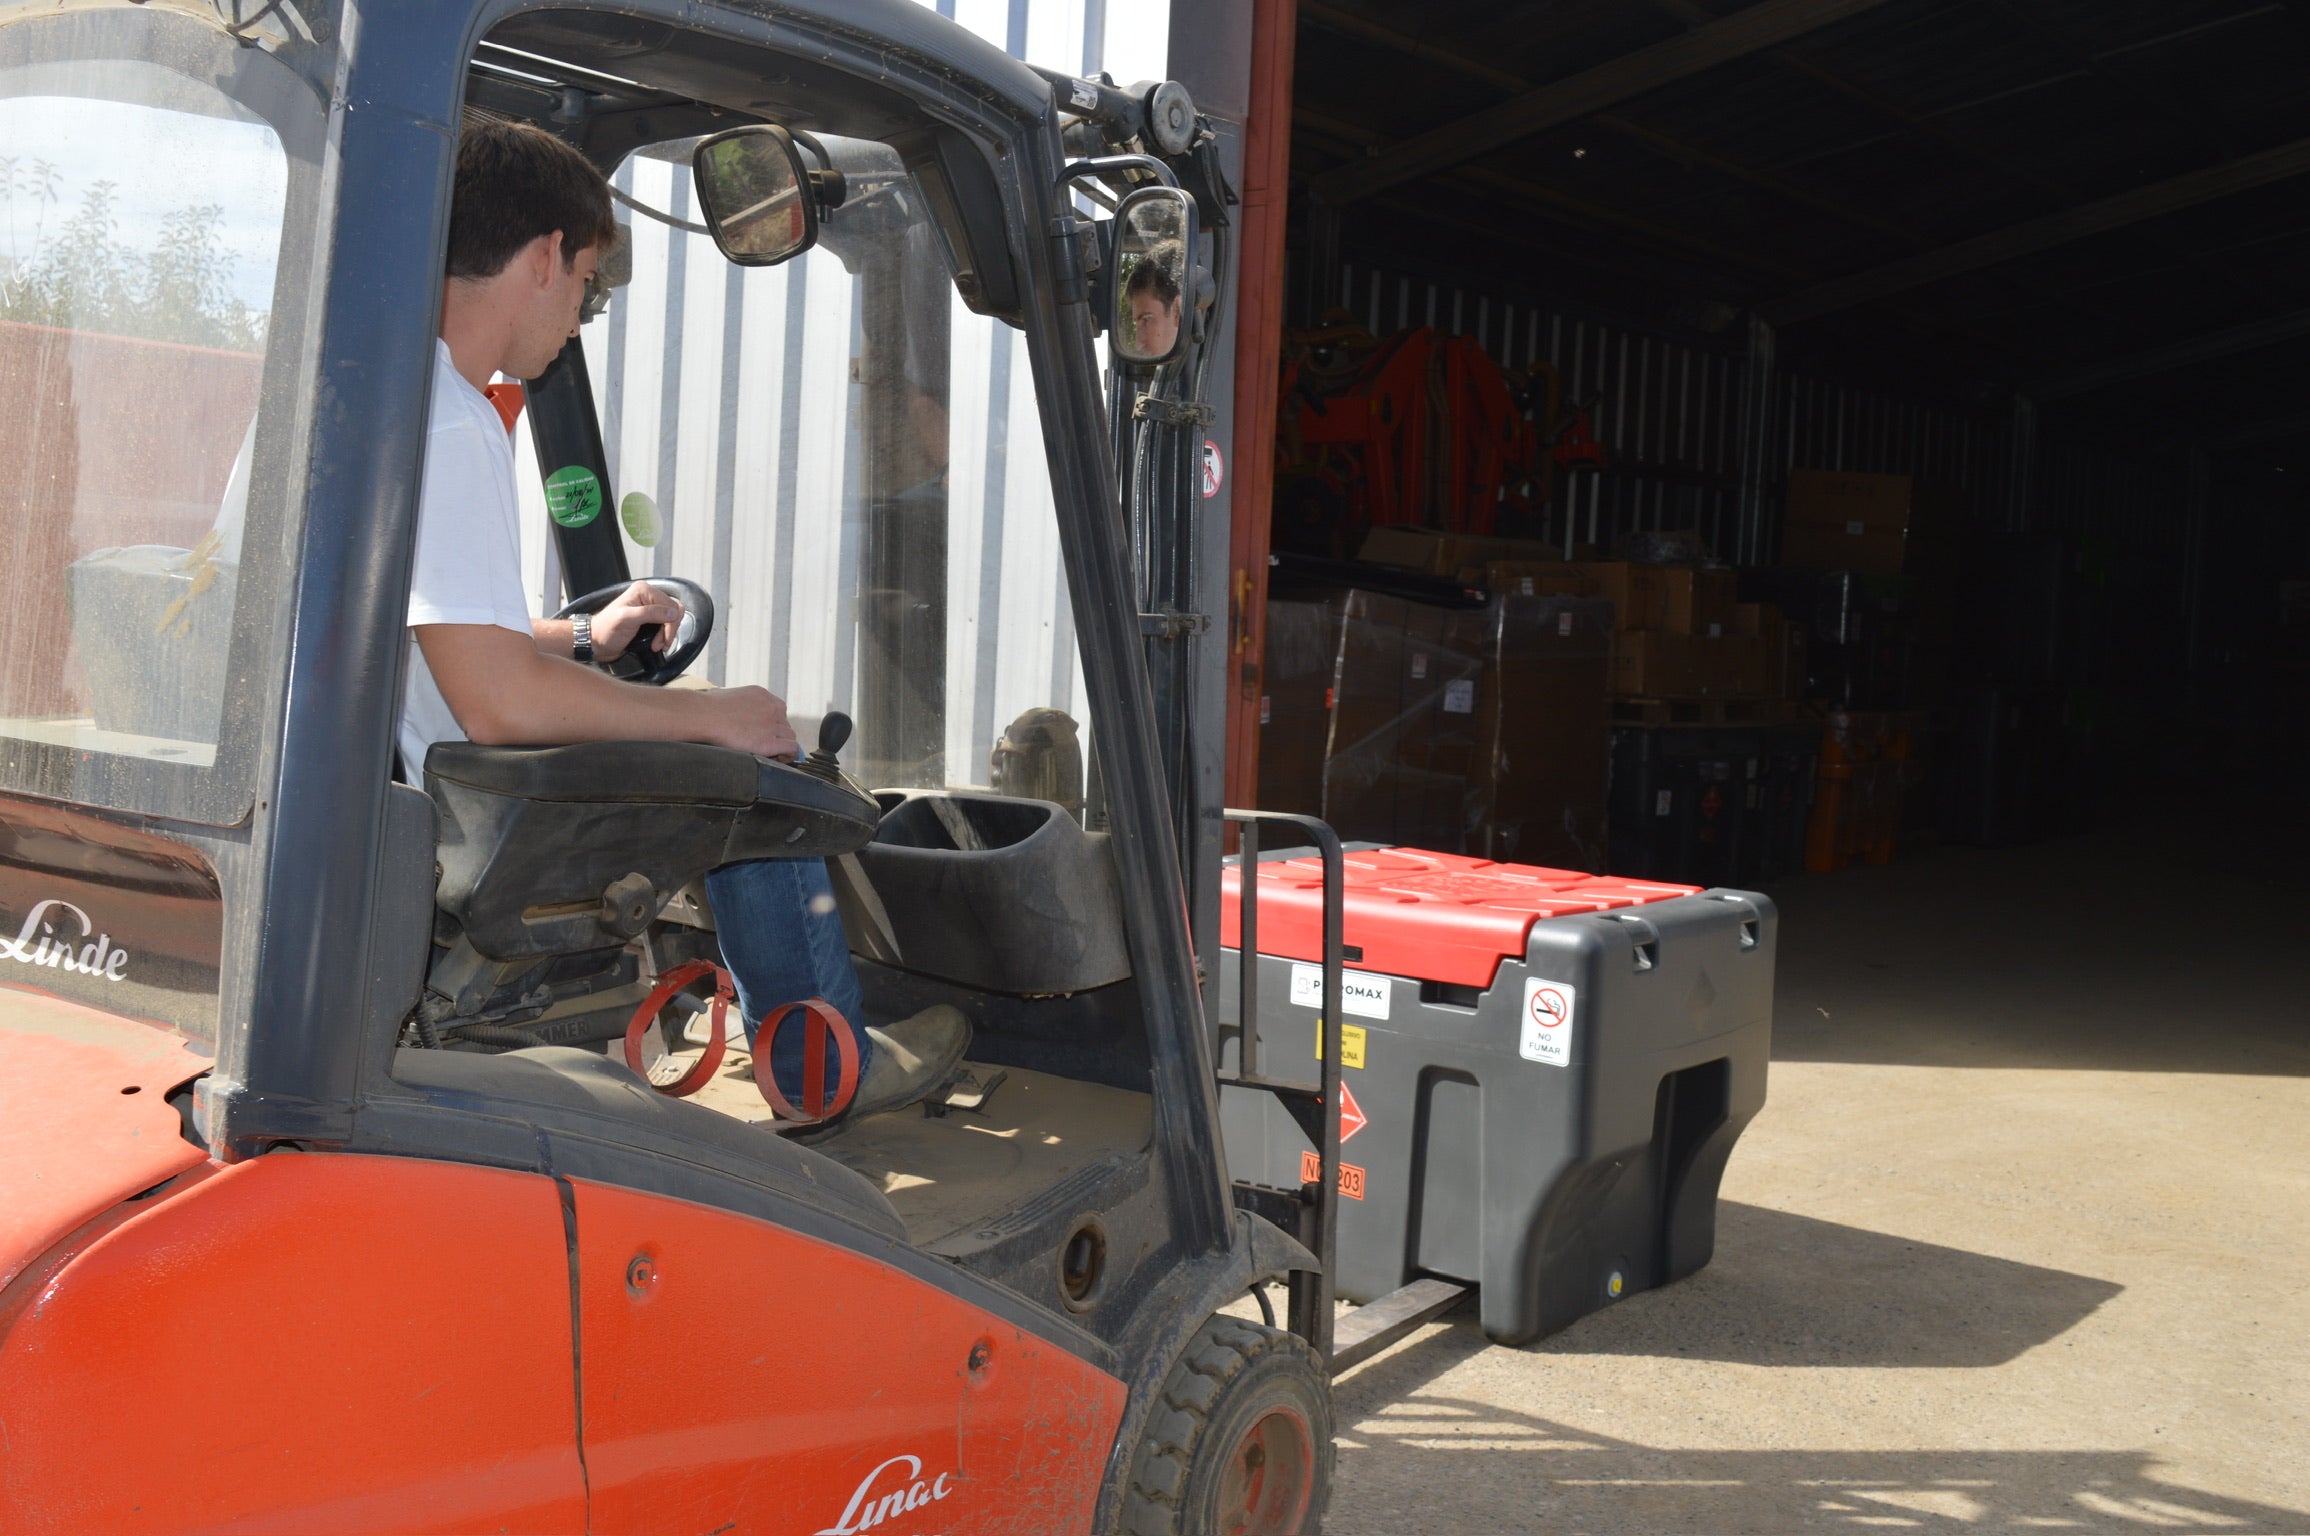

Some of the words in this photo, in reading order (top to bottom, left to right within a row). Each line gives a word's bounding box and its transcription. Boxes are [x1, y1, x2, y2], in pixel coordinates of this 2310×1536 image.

[0, 899, 128, 982] Linde
[1313, 980, 1383, 1000] POMAX
[1537, 1032, 1551, 1042] NO
[1529, 1042, 1561, 1055] FUMAR
[1338, 1168, 1360, 1192] 203
